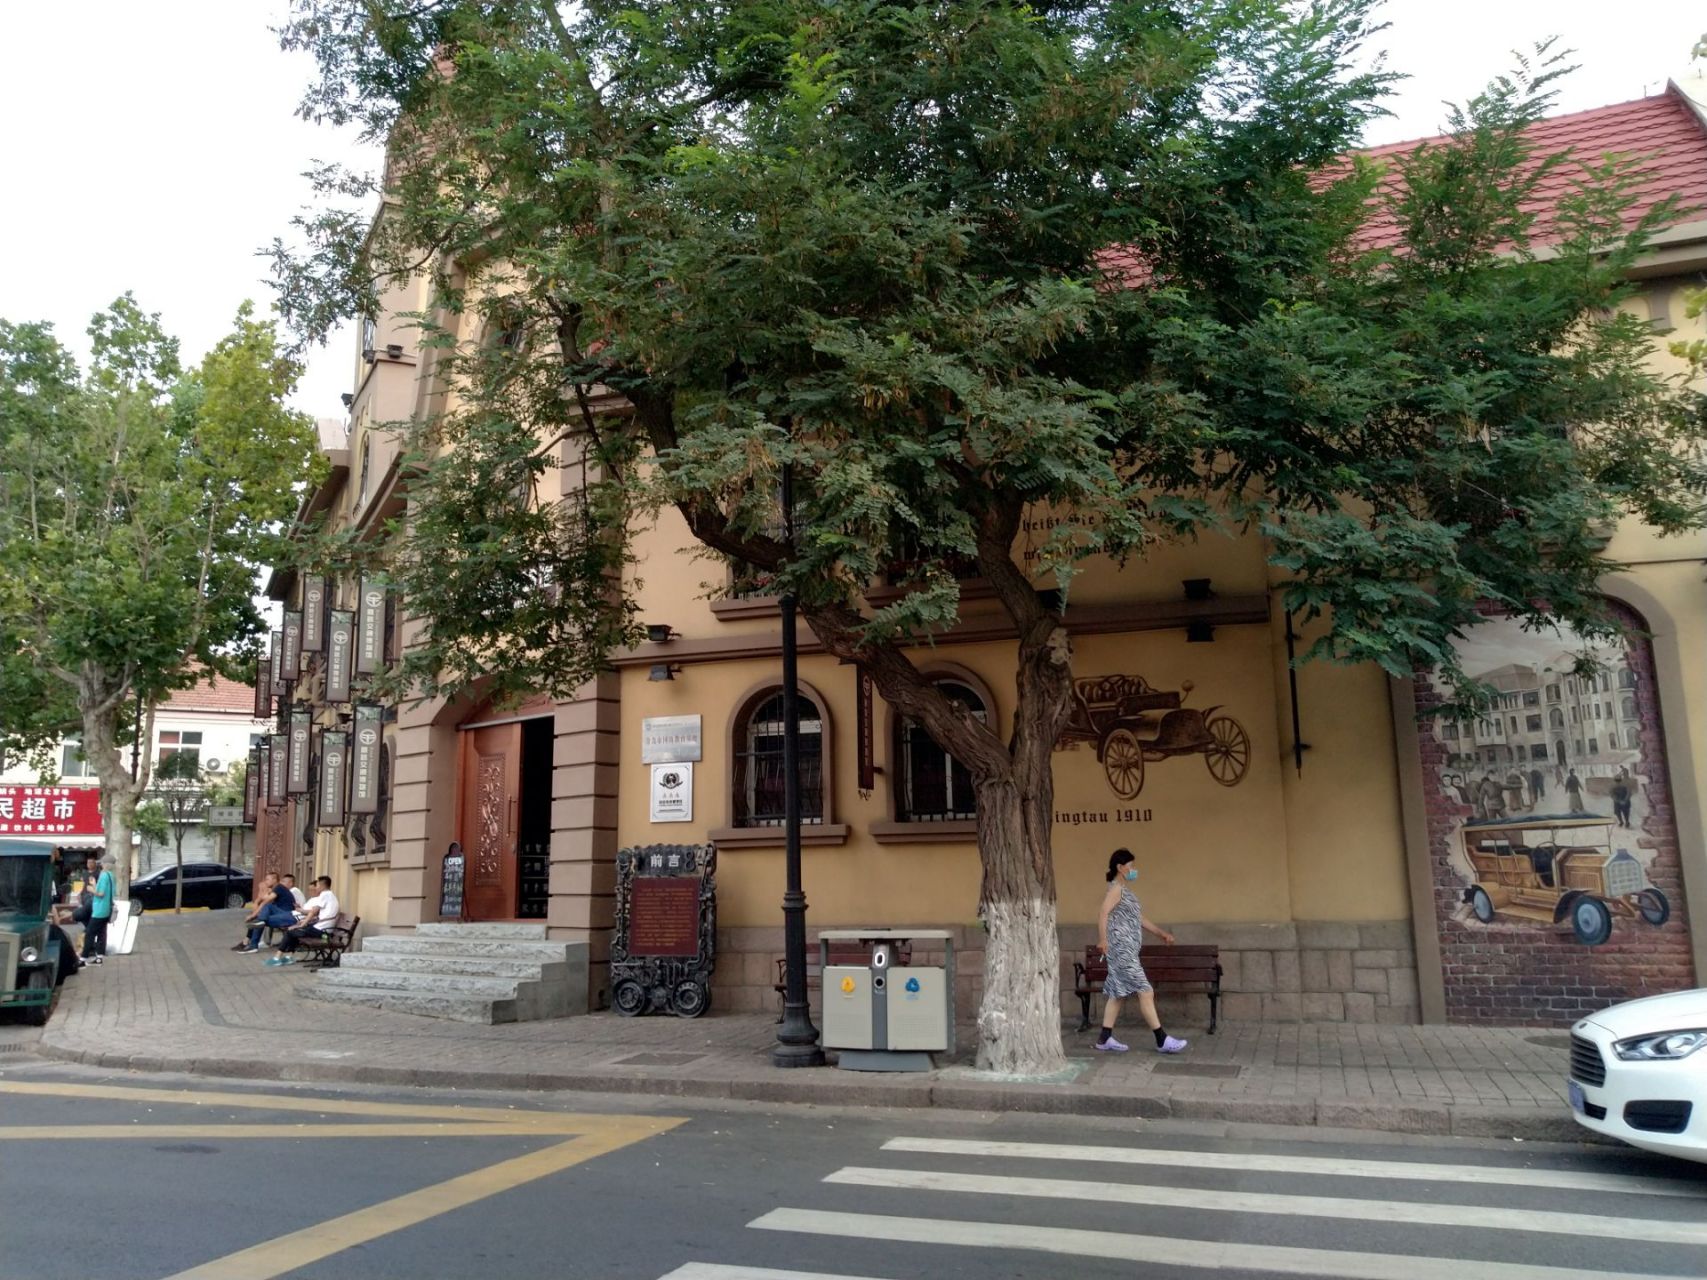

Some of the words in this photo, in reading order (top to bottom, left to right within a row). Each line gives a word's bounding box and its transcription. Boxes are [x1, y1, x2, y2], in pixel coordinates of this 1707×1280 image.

[1055, 810, 1108, 826] ingtau
[1116, 808, 1152, 823] 1910
[650, 853, 680, 868] 前言
